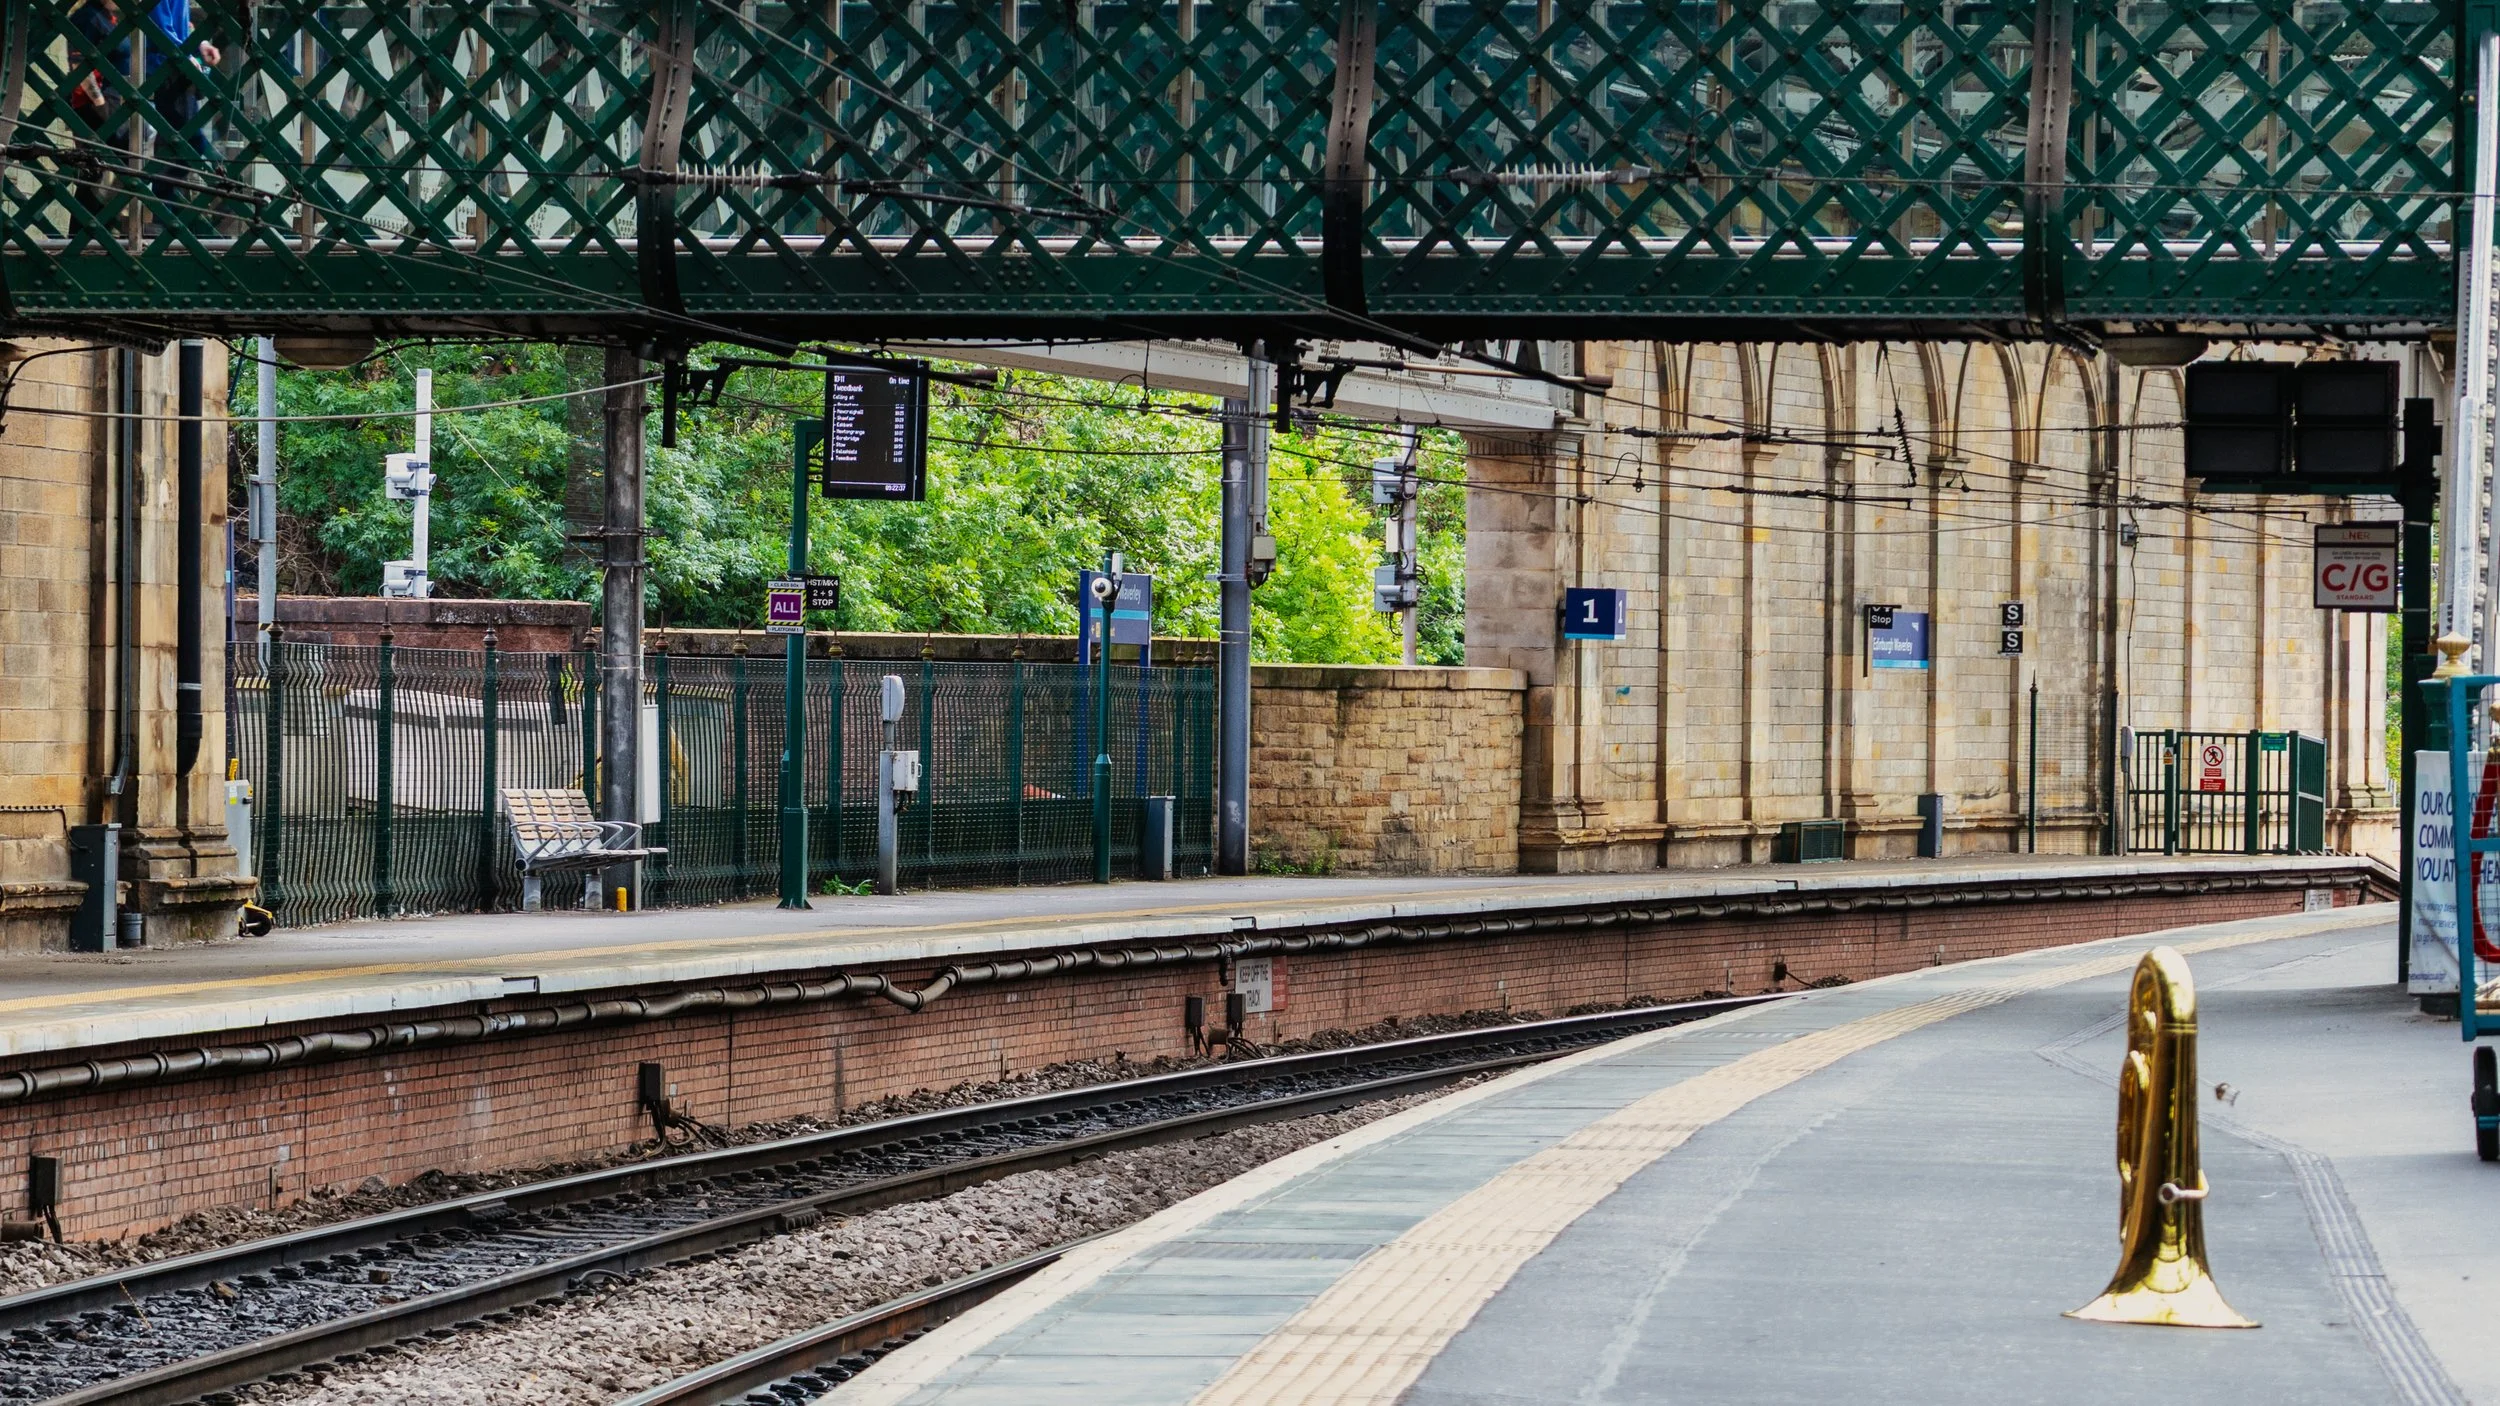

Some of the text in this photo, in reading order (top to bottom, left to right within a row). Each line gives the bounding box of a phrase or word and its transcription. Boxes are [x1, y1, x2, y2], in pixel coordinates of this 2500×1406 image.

[2342, 531, 2370, 540] LNER
[2322, 564, 2388, 592] C/G
[774, 602, 798, 613] ALL
[1583, 599, 1598, 623] 1
[1618, 600, 1623, 623] 1
[2007, 605, 2019, 620] S
[1871, 615, 1891, 625] Stop
[1872, 637, 1912, 655] Edinburgh Waverley
[2007, 633, 2018, 648] S
[2421, 791, 2444, 815] OUR
[2416, 857, 2440, 882] YOU
